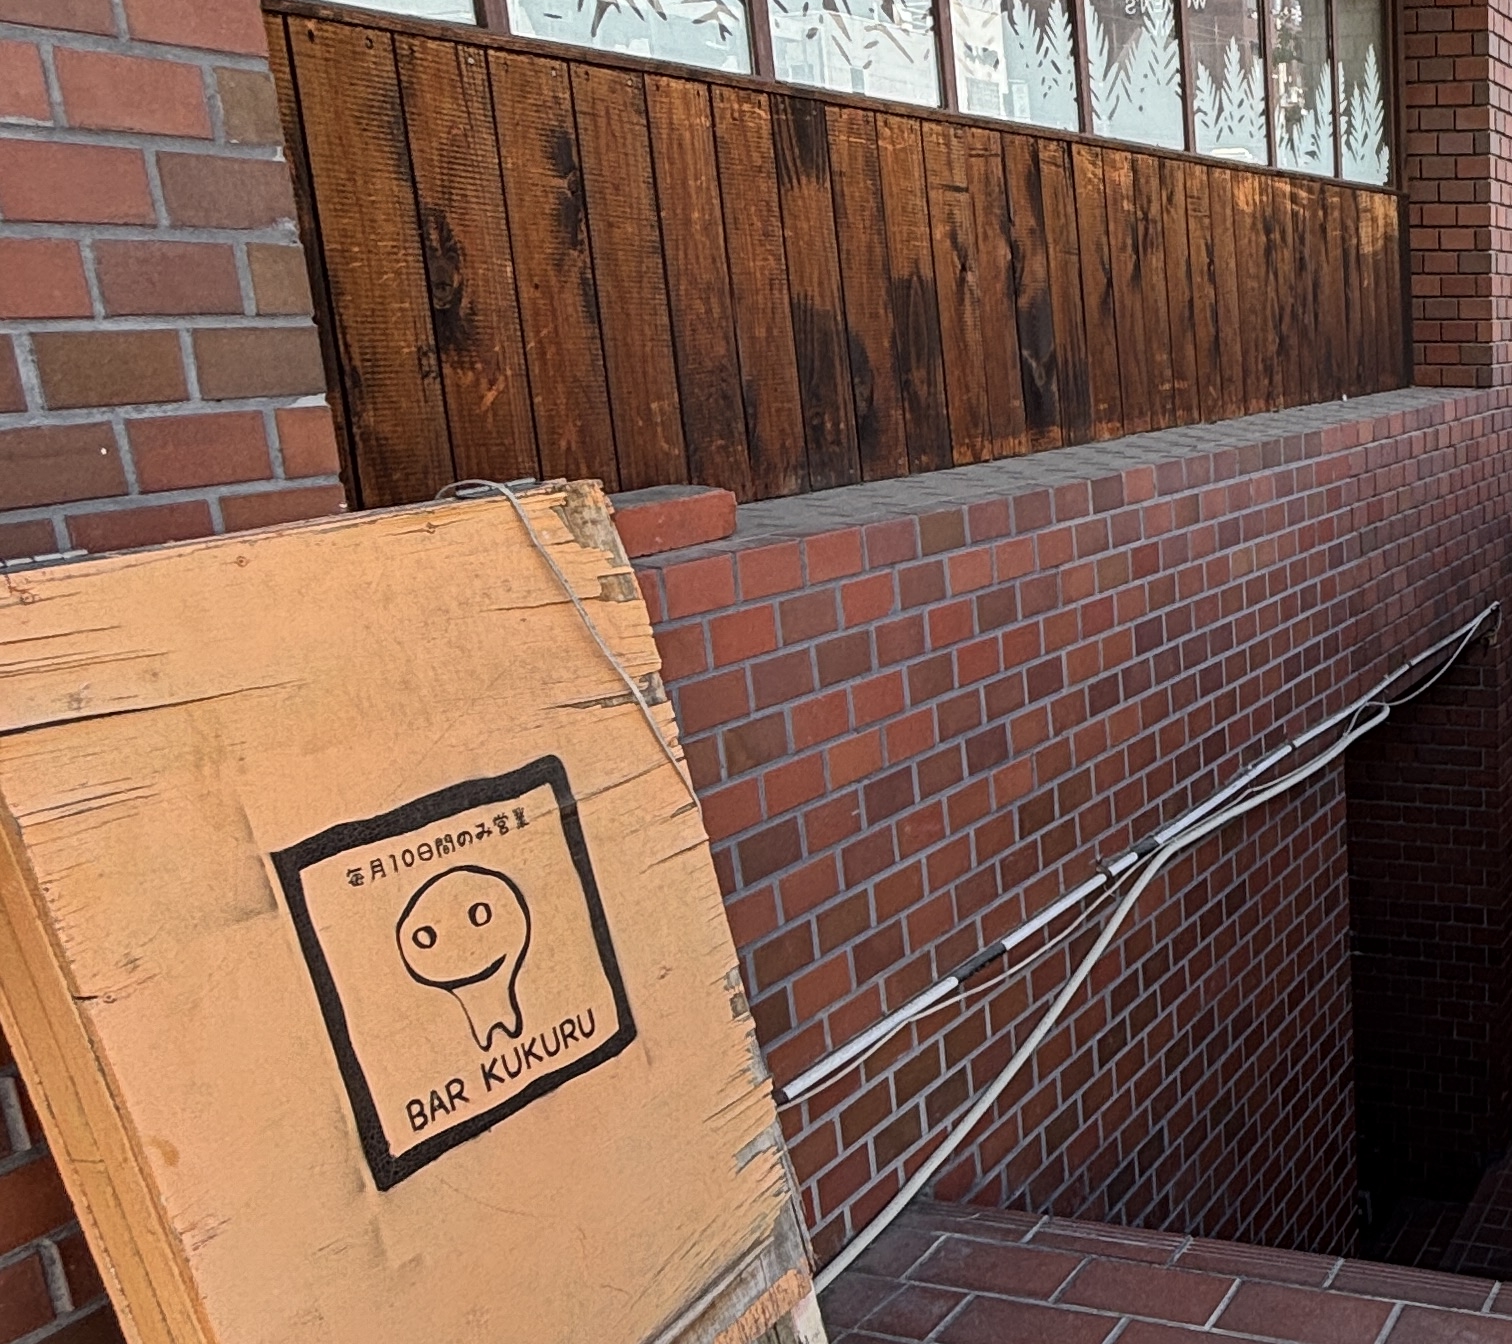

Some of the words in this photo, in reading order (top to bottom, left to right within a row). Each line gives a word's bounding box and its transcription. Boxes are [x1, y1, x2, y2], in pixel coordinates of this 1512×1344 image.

[346, 806, 530, 887] 毎月10日間のみ営業
[405, 1077, 470, 1131] BAR
[480, 1008, 596, 1092] KUKURU
